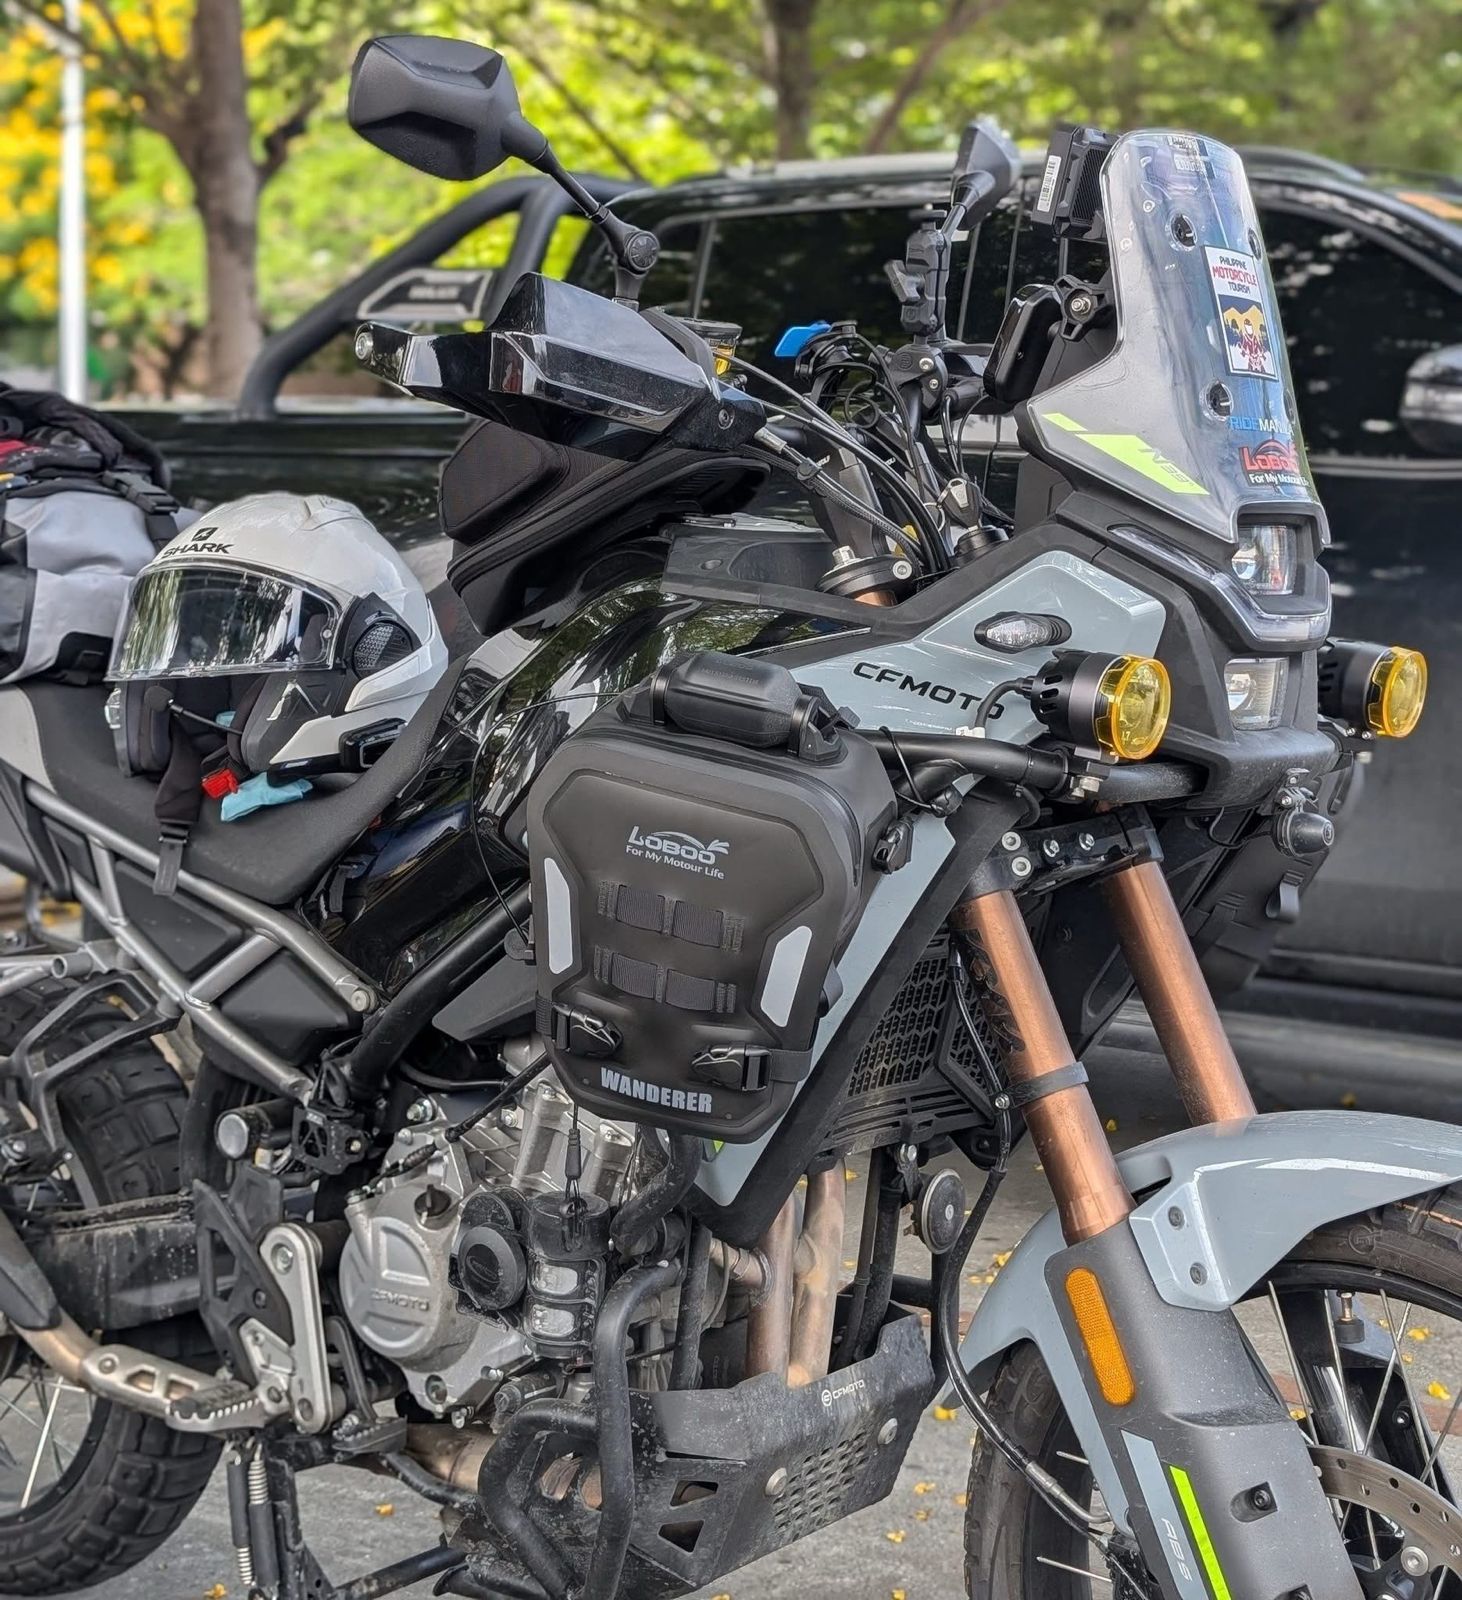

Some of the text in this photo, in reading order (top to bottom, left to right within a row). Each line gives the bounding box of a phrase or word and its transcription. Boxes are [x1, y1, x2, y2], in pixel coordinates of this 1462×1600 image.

[1211, 265, 1258, 287] MOTORCYCLE
[1248, 473, 1265, 484] For
[1264, 473, 1278, 485] My
[160, 543, 234, 559] SHARK
[853, 662, 1005, 720] CFMOTO
[625, 845, 725, 880] For My Motour Life
[627, 826, 716, 865] LOBOO
[600, 1066, 713, 1114] WANDERER
[832, 1379, 865, 1399] CFMOTO
[1161, 1517, 1193, 1582] ABS
